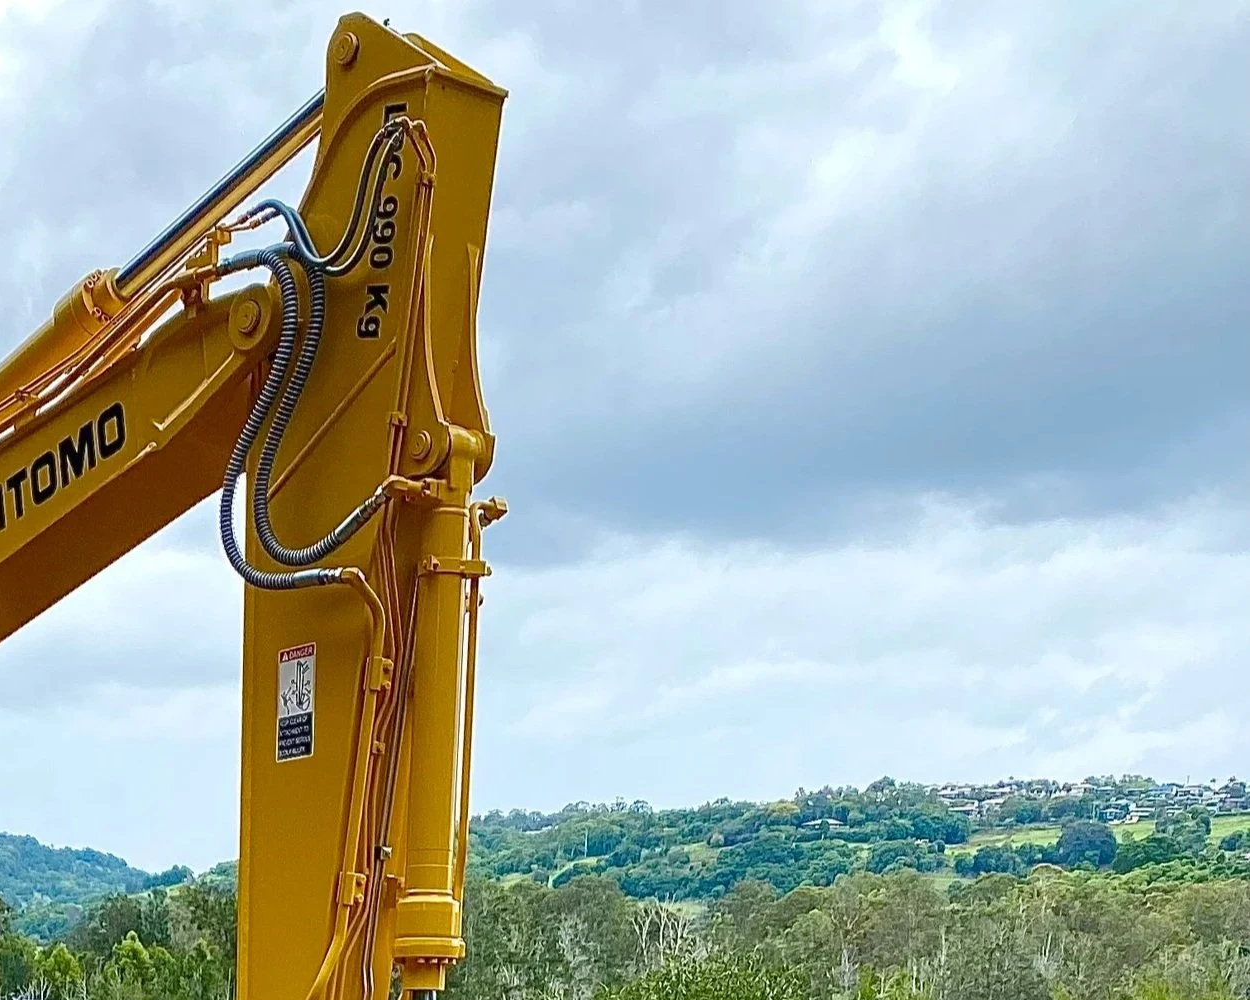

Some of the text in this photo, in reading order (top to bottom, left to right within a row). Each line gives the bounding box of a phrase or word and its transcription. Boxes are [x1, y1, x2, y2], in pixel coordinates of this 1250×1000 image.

[369, 195, 400, 269] 990
[356, 283, 390, 340] Kg
[289, 646, 313, 660] DANGER
